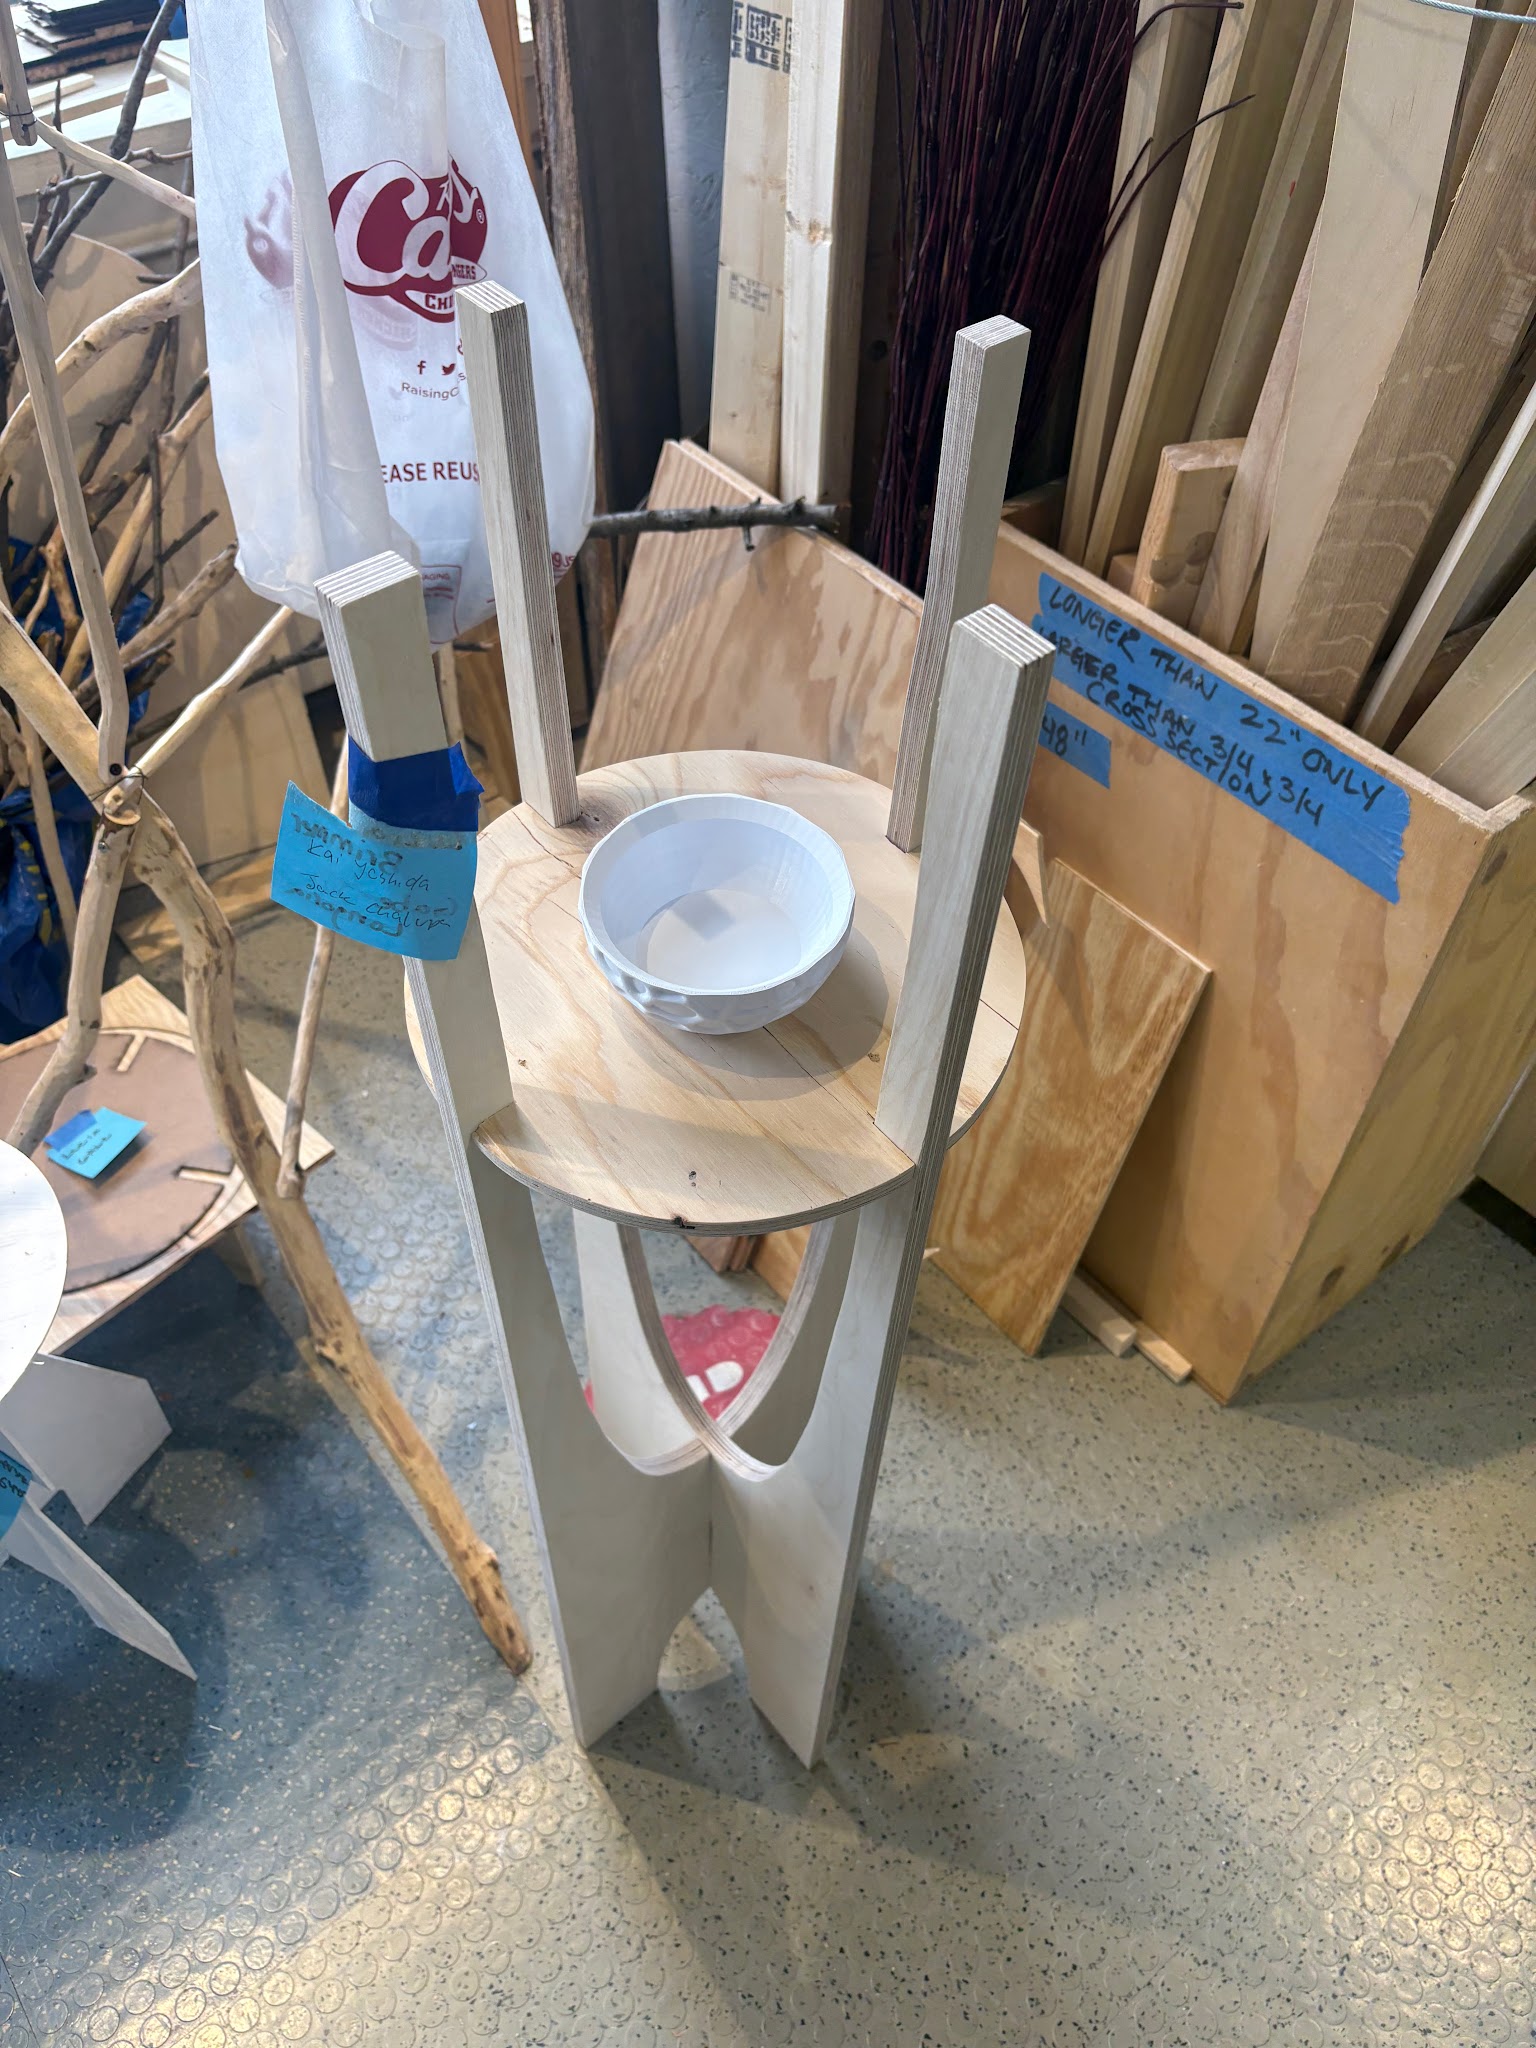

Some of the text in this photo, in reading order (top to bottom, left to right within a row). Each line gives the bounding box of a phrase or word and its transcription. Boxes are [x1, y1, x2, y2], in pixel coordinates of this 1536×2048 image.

[1049, 586, 1385, 812] LONGER THAN 22" ONLY
[1086, 681, 1272, 806] CROSS SECTION
[1127, 683, 1196, 737] THAN
[1210, 735, 1254, 782] 3/4
[1278, 776, 1324, 826] 3/4
[307, 839, 343, 863] Kai
